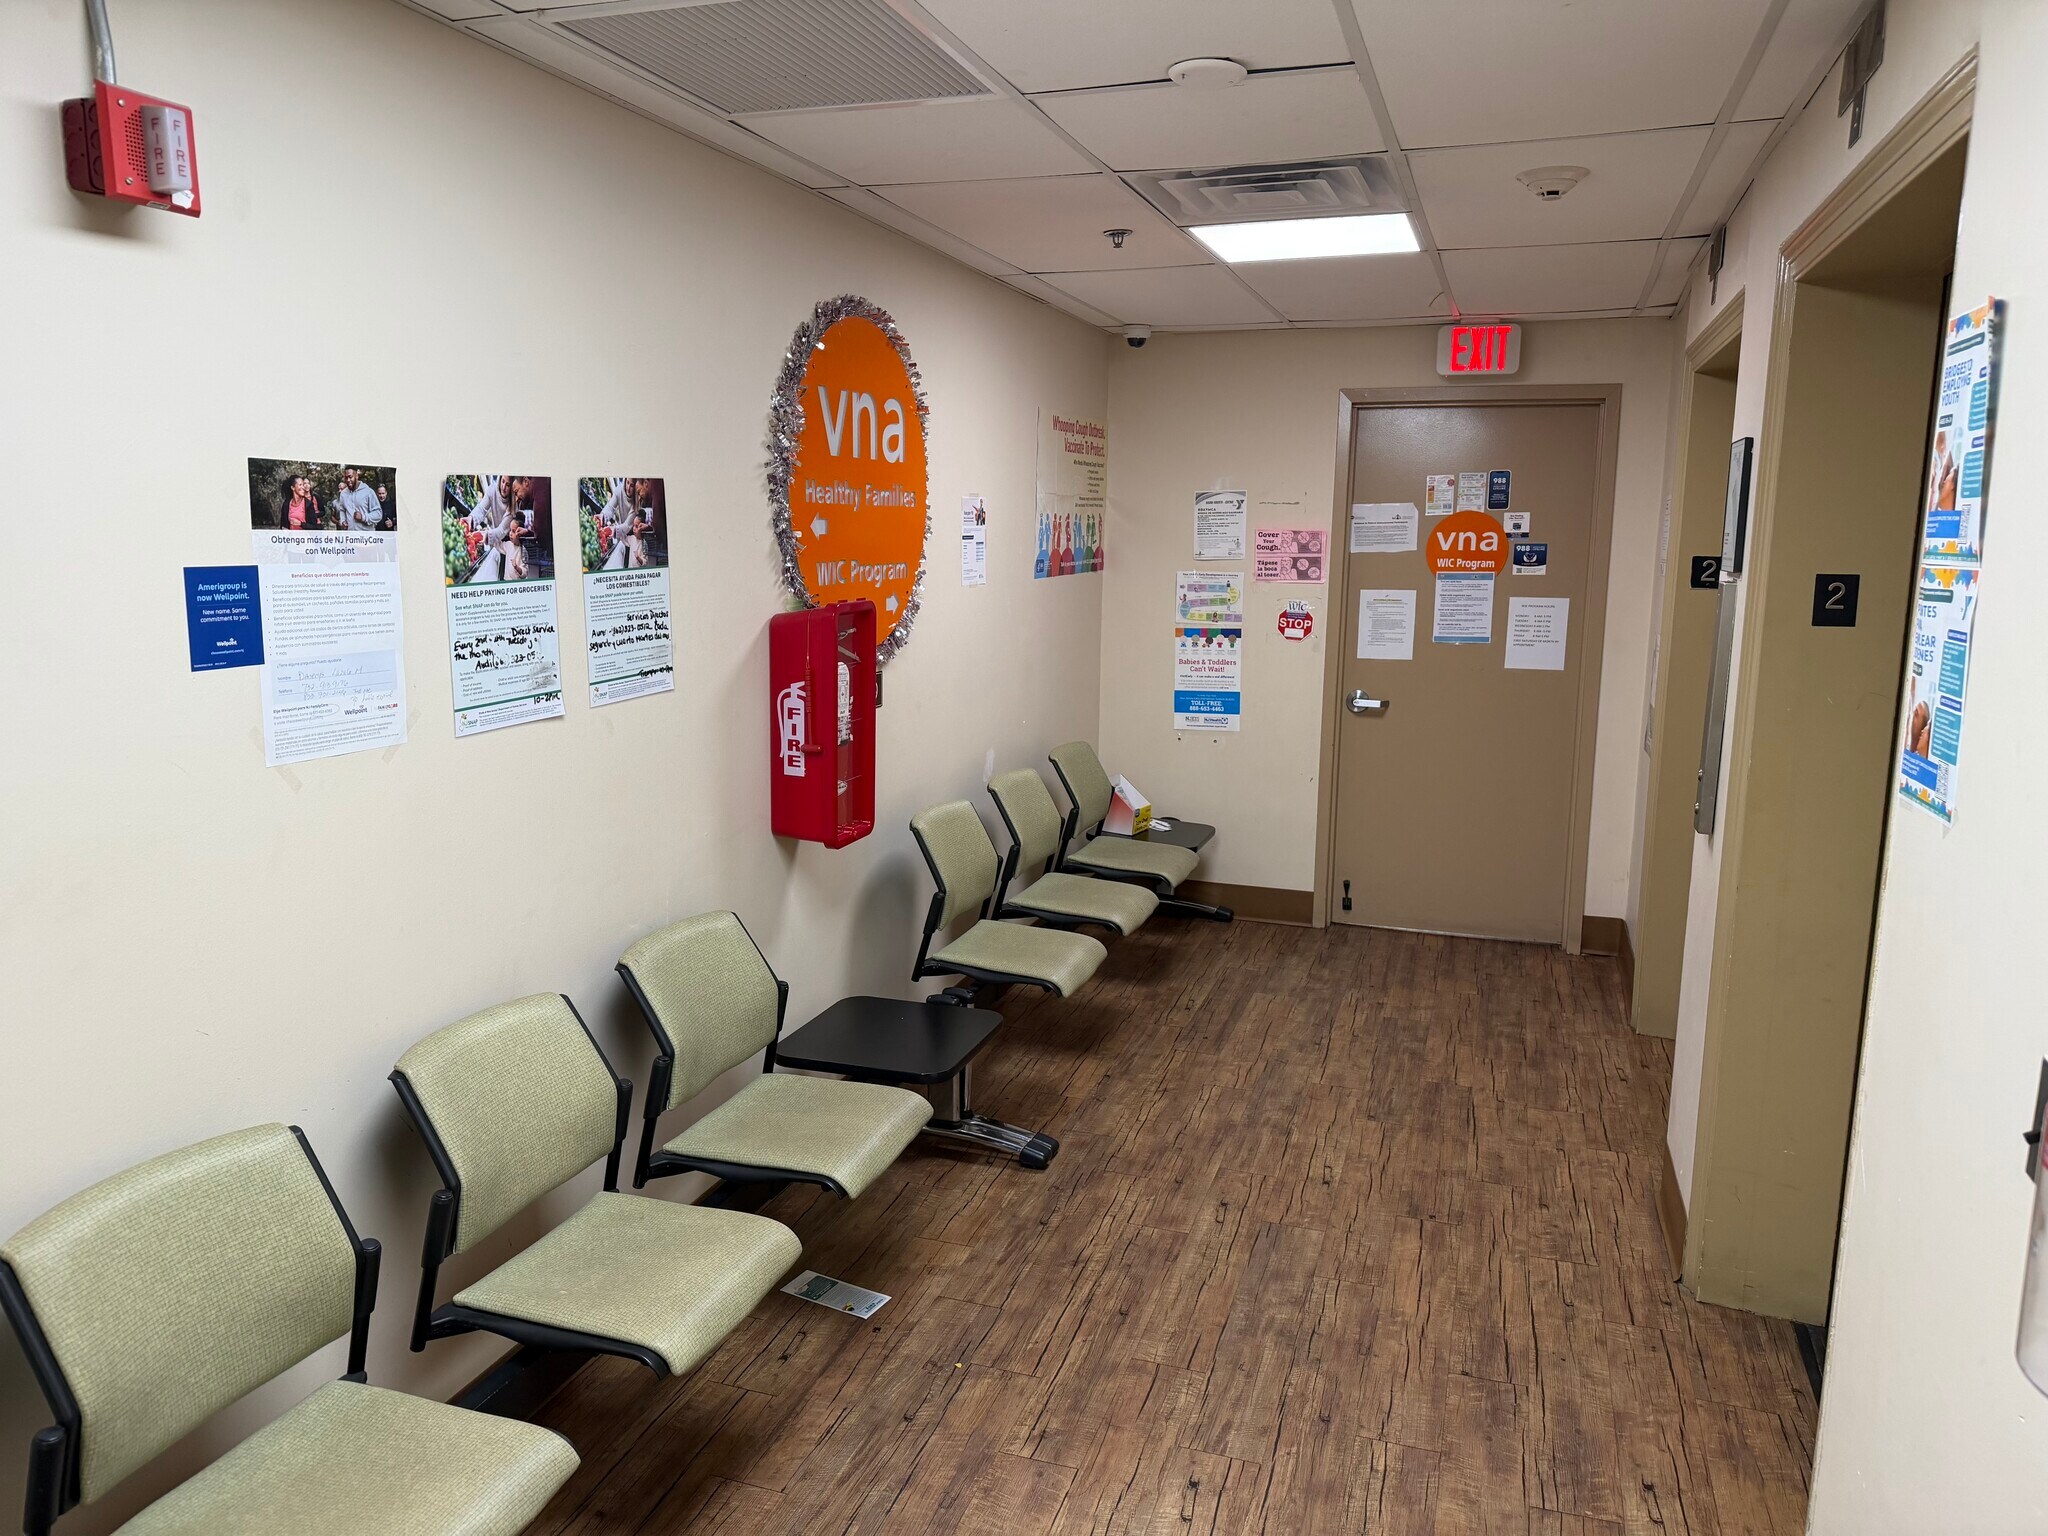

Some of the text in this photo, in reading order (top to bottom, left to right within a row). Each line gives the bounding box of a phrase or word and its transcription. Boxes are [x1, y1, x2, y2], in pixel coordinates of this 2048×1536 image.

[151, 117, 165, 175] FIRE
[173, 119, 187, 178] FIRE
[1450, 326, 1512, 372] EXIT
[1942, 391, 1960, 407] YOUTH
[818, 385, 905, 464] vna
[1052, 415, 1074, 437] Whooping
[1076, 420, 1088, 439] Cough
[1064, 437, 1084, 454] Vaccinate
[1085, 441, 1090, 455] To
[805, 479, 916, 511] Healthy Families
[271, 534, 384, 546] Obtenga más de NJ FamilyCare
[1436, 531, 1499, 551] vna
[320, 546, 355, 557] Wellpoint
[1437, 558, 1495, 570] WIC Program
[1700, 559, 1717, 582] 2
[593, 576, 618, 585] ¿NECESITA
[816, 559, 908, 587] WIC Program
[198, 582, 240, 591] Amerigroup
[451, 584, 552, 599] NEED HELP PAYING FOR GROCERIES?
[616, 580, 650, 589] COMESTIBLES?
[197, 592, 250, 602] now Wellpoint.
[1825, 582, 1846, 610] 2
[200, 615, 233, 623] commitment
[1280, 619, 1312, 629] STOP
[512, 626, 531, 637] Direct
[454, 640, 474, 652] Every
[454, 653, 468, 661] the
[344, 707, 368, 716] Wellpoint
[788, 707, 801, 768] FIRE
